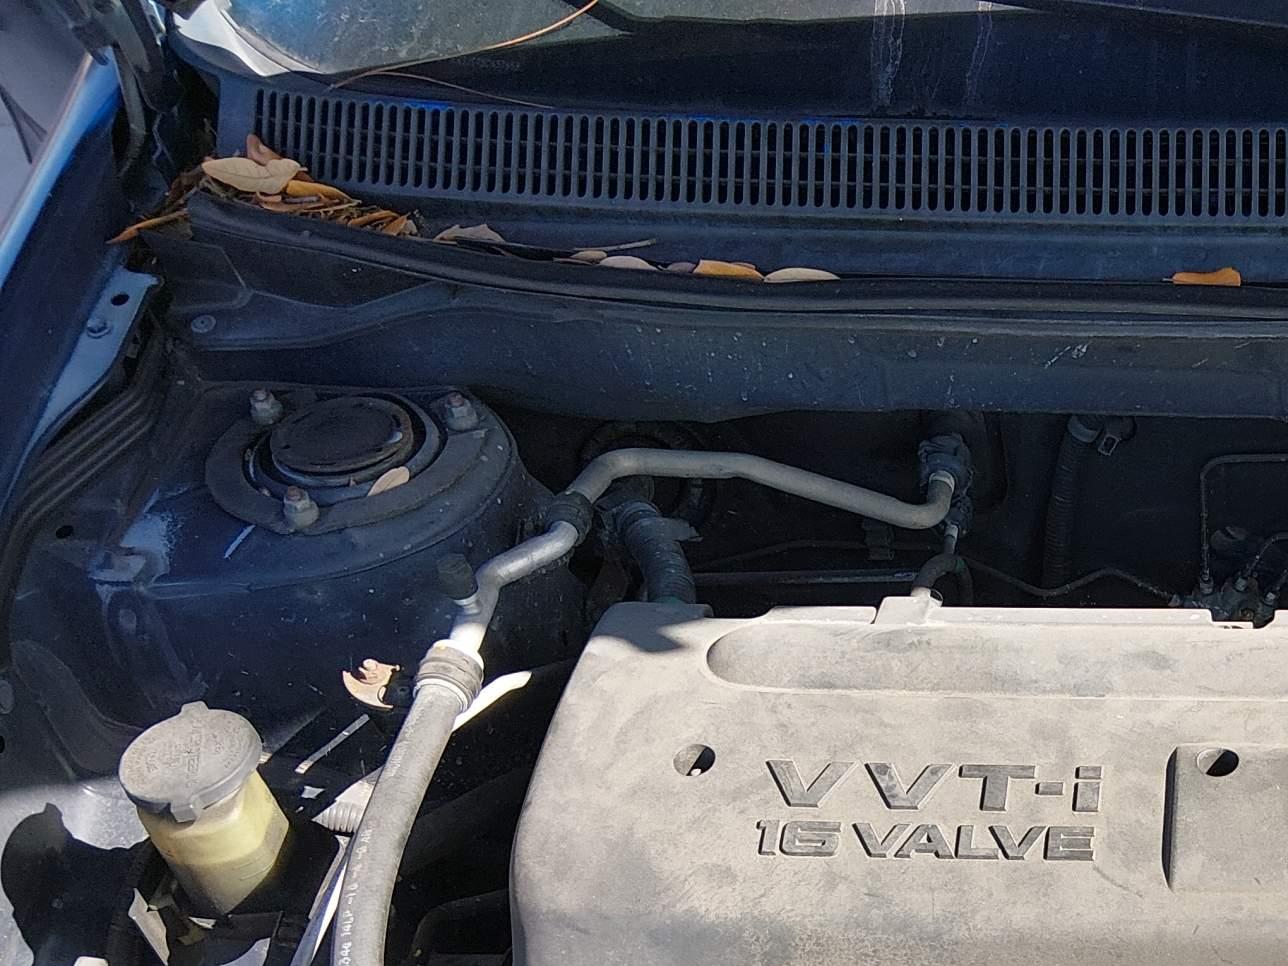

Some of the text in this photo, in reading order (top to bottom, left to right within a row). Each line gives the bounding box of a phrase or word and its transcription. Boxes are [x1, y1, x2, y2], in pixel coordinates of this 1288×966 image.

[766, 760, 1103, 812] VVT-i
[755, 819, 1096, 862] 16 VALVE
